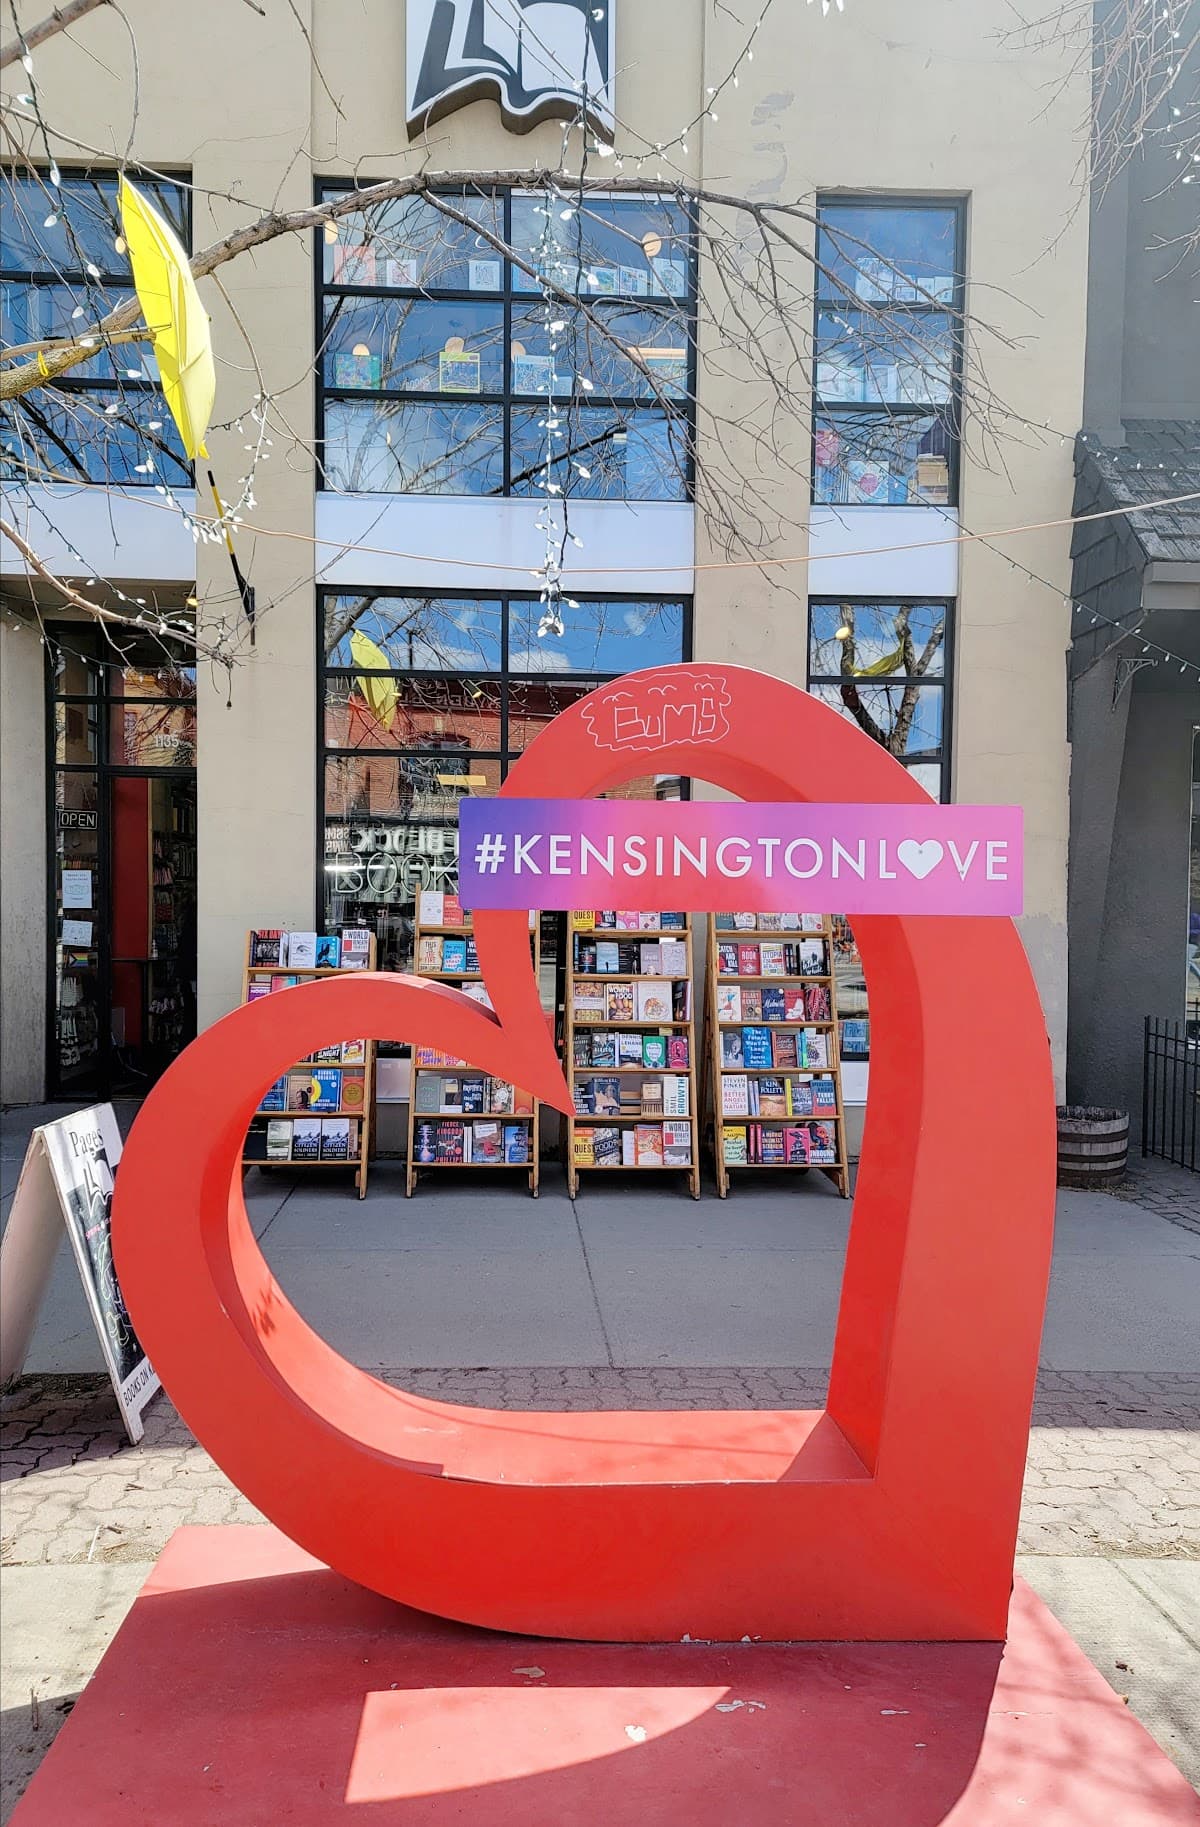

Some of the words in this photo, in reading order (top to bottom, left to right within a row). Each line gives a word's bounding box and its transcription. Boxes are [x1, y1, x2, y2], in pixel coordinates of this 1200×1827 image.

[154, 733, 179, 747] 1135
[61, 812, 95, 827] OPEN
[347, 931, 369, 940] WORLD
[677, 1078, 686, 1115] GROWTH
[668, 1122, 689, 1132] WORLD
[68, 1129, 104, 1157] Pages
[123, 1376, 142, 1407] BOOKS
